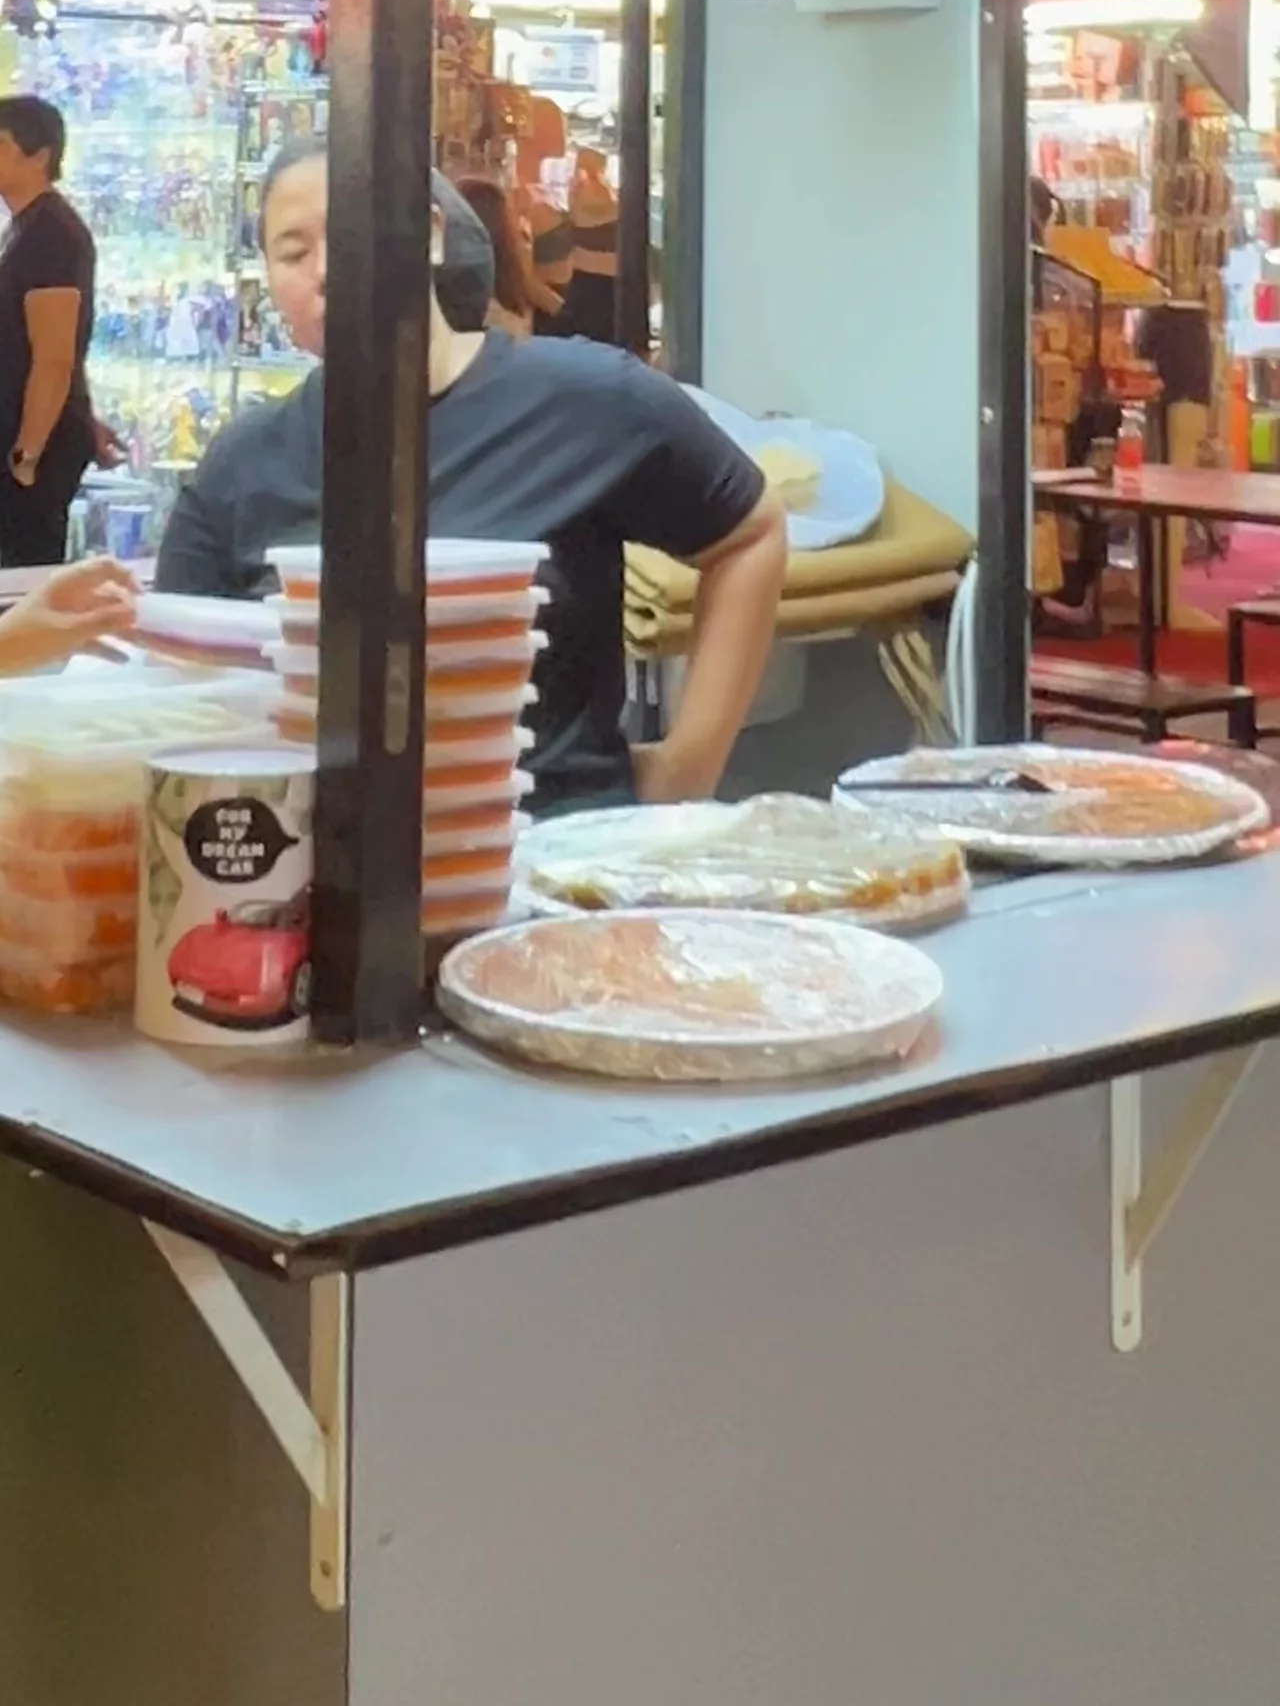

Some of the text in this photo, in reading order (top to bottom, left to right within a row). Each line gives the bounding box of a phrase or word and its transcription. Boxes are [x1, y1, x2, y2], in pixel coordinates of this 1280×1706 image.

[215, 808, 253, 825] FOR
[219, 826, 248, 841] MY
[201, 842, 265, 858] DREAM
[216, 859, 254, 875] CAR
